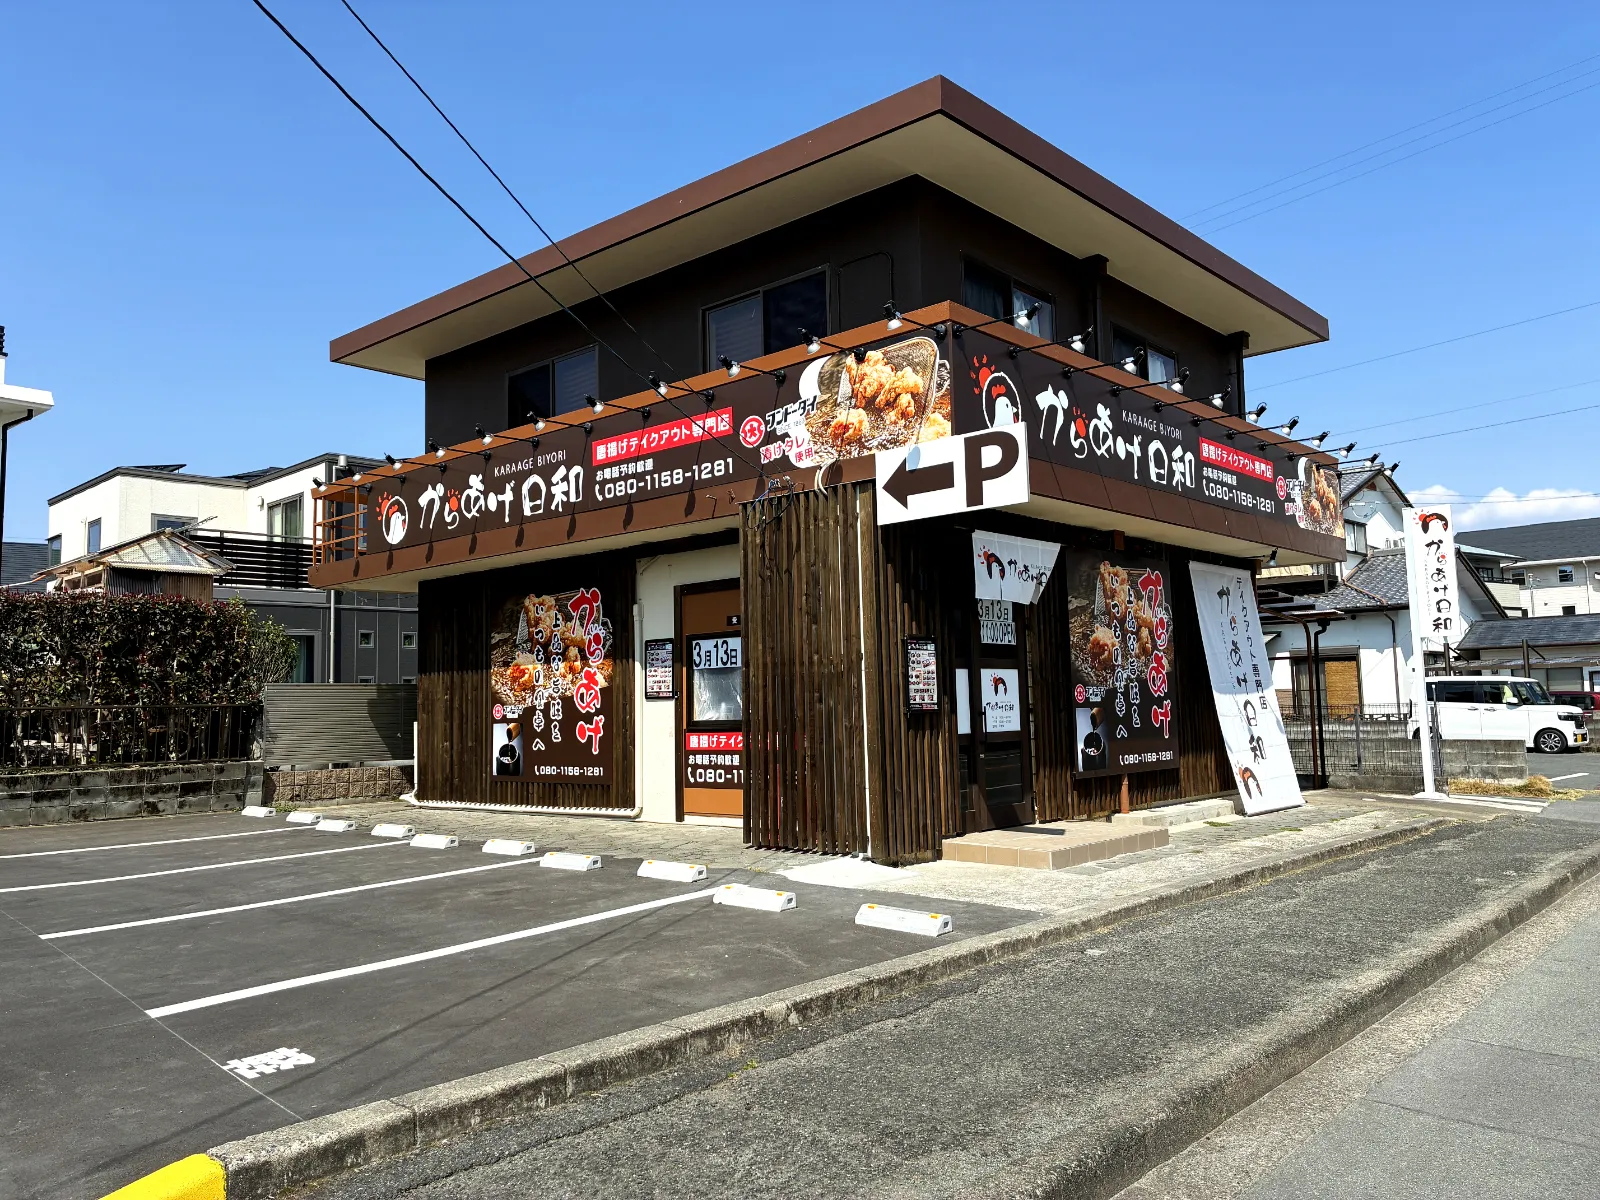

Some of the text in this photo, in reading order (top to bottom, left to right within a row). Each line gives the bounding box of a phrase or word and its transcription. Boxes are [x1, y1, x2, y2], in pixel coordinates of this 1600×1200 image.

[767, 395, 818, 429] フンドーダイ
[1122, 410, 1182, 440] KARAAGE BIYORI
[597, 414, 730, 460] 唐揚げテイクアウト専門店
[761, 436, 805, 461] 漬けタレ
[795, 447, 813, 463] 使用
[1036, 384, 1195, 491] からあげ日和
[494, 450, 566, 477] KARAAGE BIYORI
[596, 458, 654, 481] お電話予約歓迎
[605, 458, 733, 498] 080-1158-1281
[964, 431, 1019, 507] P
[1202, 442, 1273, 479] 唐揚げテイクアウト専門店
[418, 465, 583, 529] からあげ日和
[1210, 484, 1275, 513] 080-1158-1281
[1425, 539, 1452, 633] からあげ日和
[977, 599, 1009, 621] 3月13日
[693, 640, 738, 668] 3月13日
[1110, 573, 1127, 739] いつもの食卓へ
[1126, 586, 1140, 727] 上品な旨味を
[1138, 568, 1171, 739] からあげ
[1236, 577, 1267, 710] テイクアウト専門店
[533, 604, 545, 751] いつもの食卓へ
[551, 611, 562, 742] 上品な旨味を
[568, 587, 605, 754] からあげ
[1217, 585, 1267, 765] からあげ日和
[540, 767, 604, 776] 080-1158-1281
[688, 754, 740, 766] お電話予約歓迎
[1124, 751, 1174, 765] 080-1158-1281
